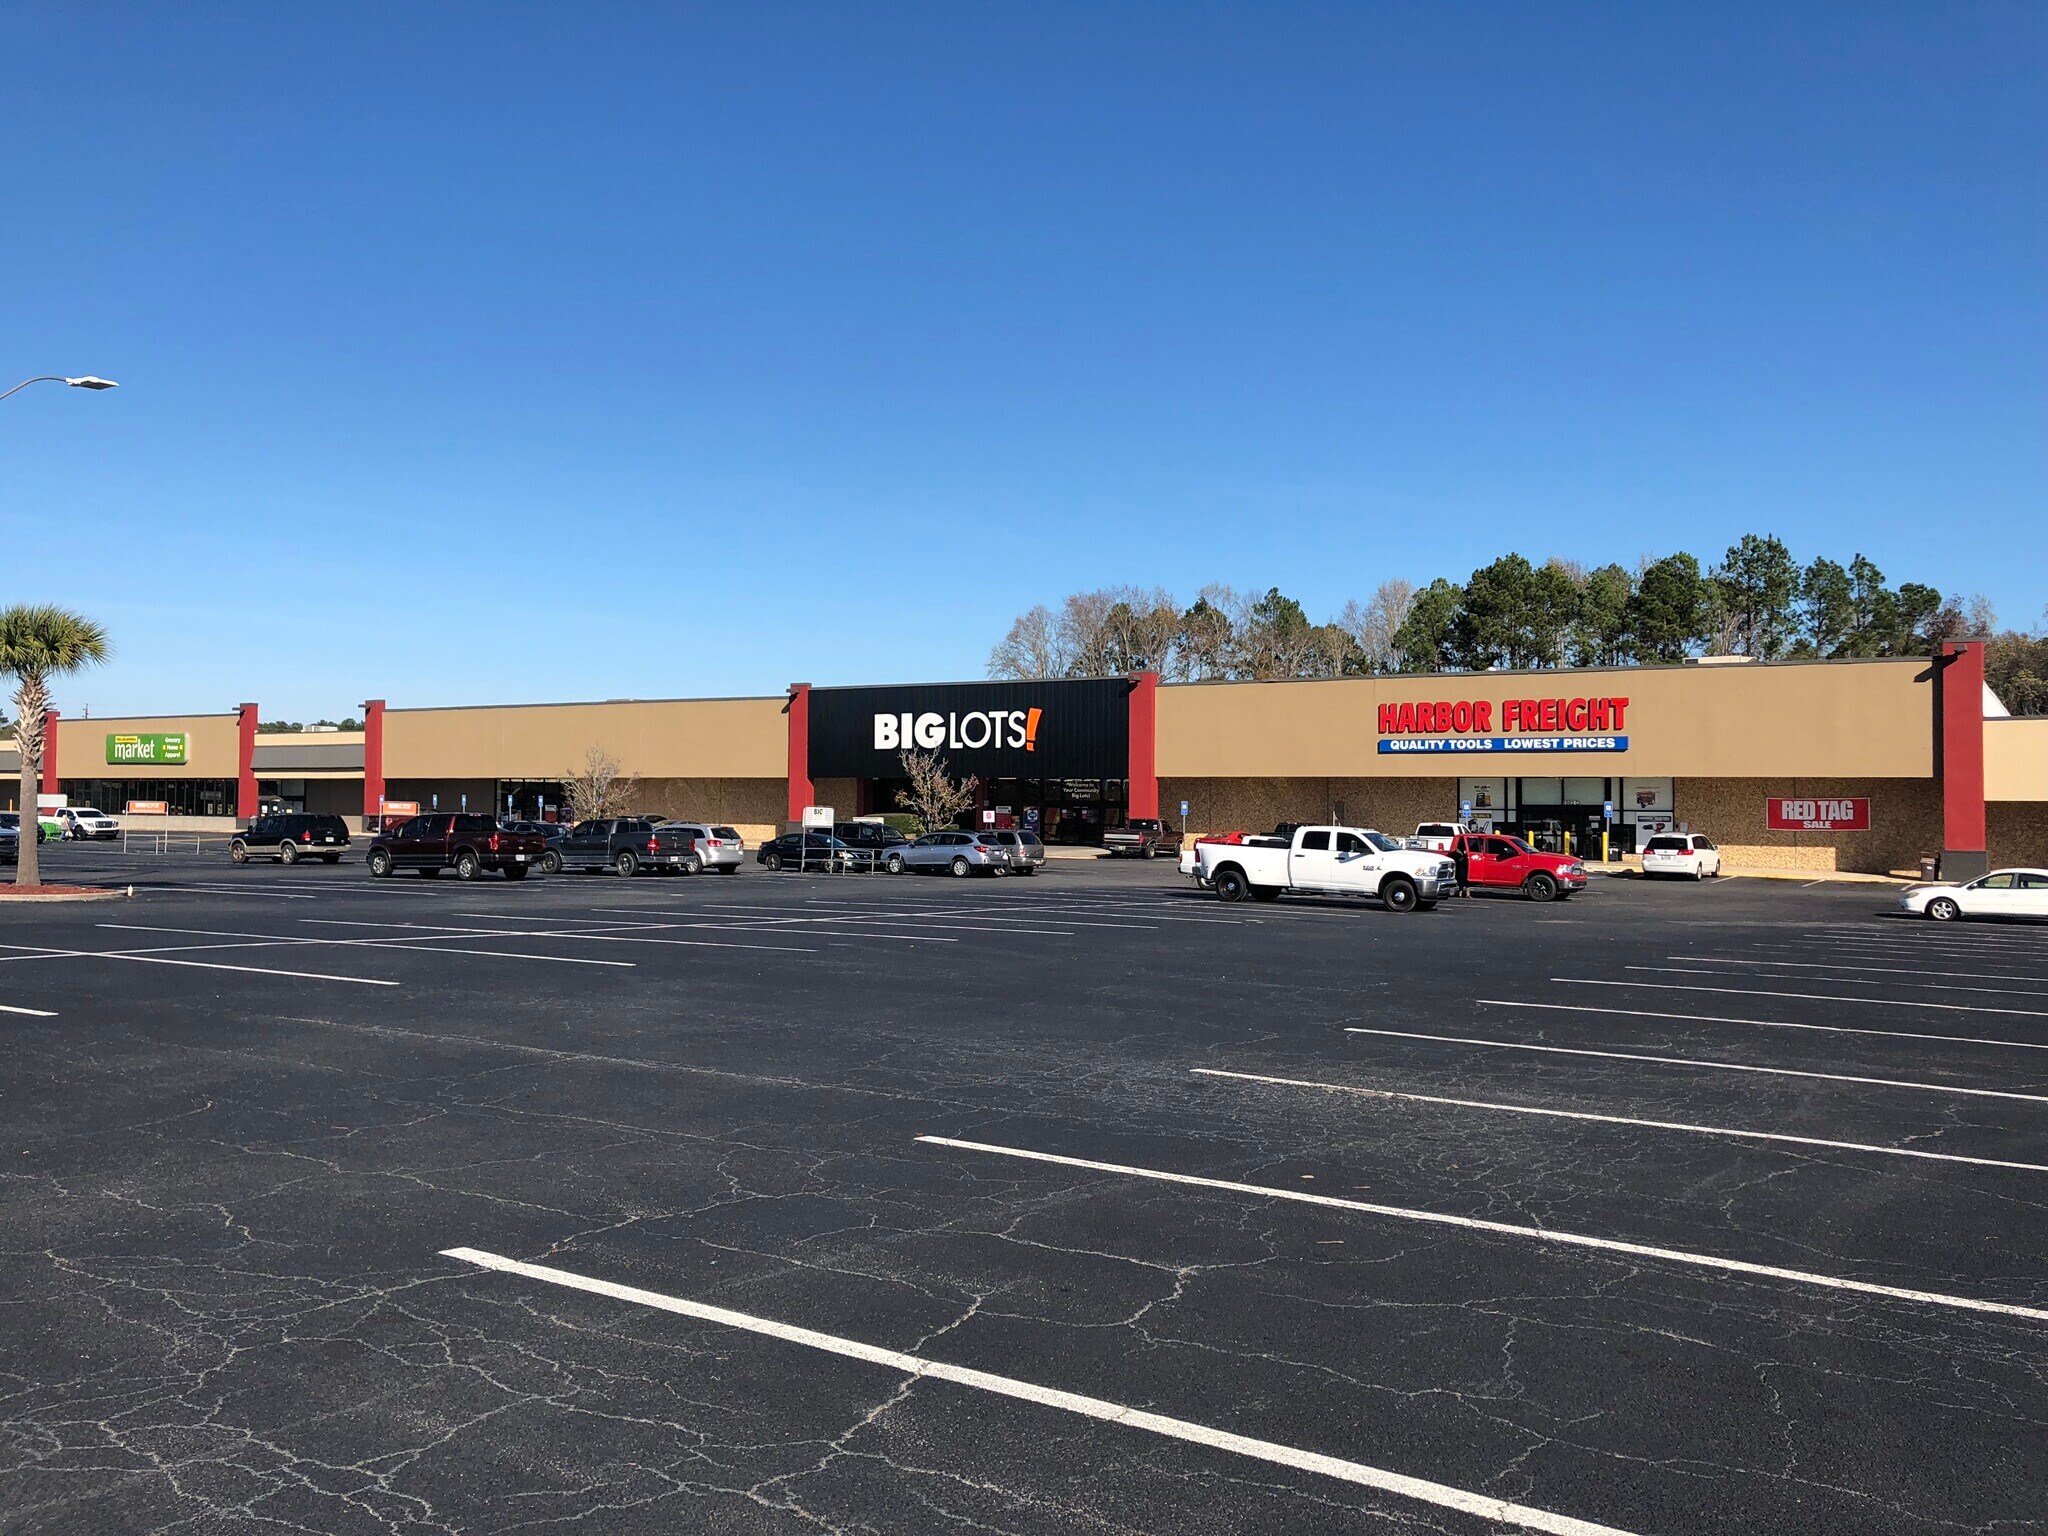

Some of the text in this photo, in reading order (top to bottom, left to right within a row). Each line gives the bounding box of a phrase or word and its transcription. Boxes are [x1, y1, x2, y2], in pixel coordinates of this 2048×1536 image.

[1378, 698, 1629, 734] HARBOR FREIGHT
[874, 707, 1043, 751] BIG LOTS!
[115, 739, 155, 760] market
[1390, 737, 1616, 750] QUALITY TOOLS LOWEST PRICES
[1781, 800, 1854, 820] RED TAG
[1803, 820, 1832, 828] SALE
